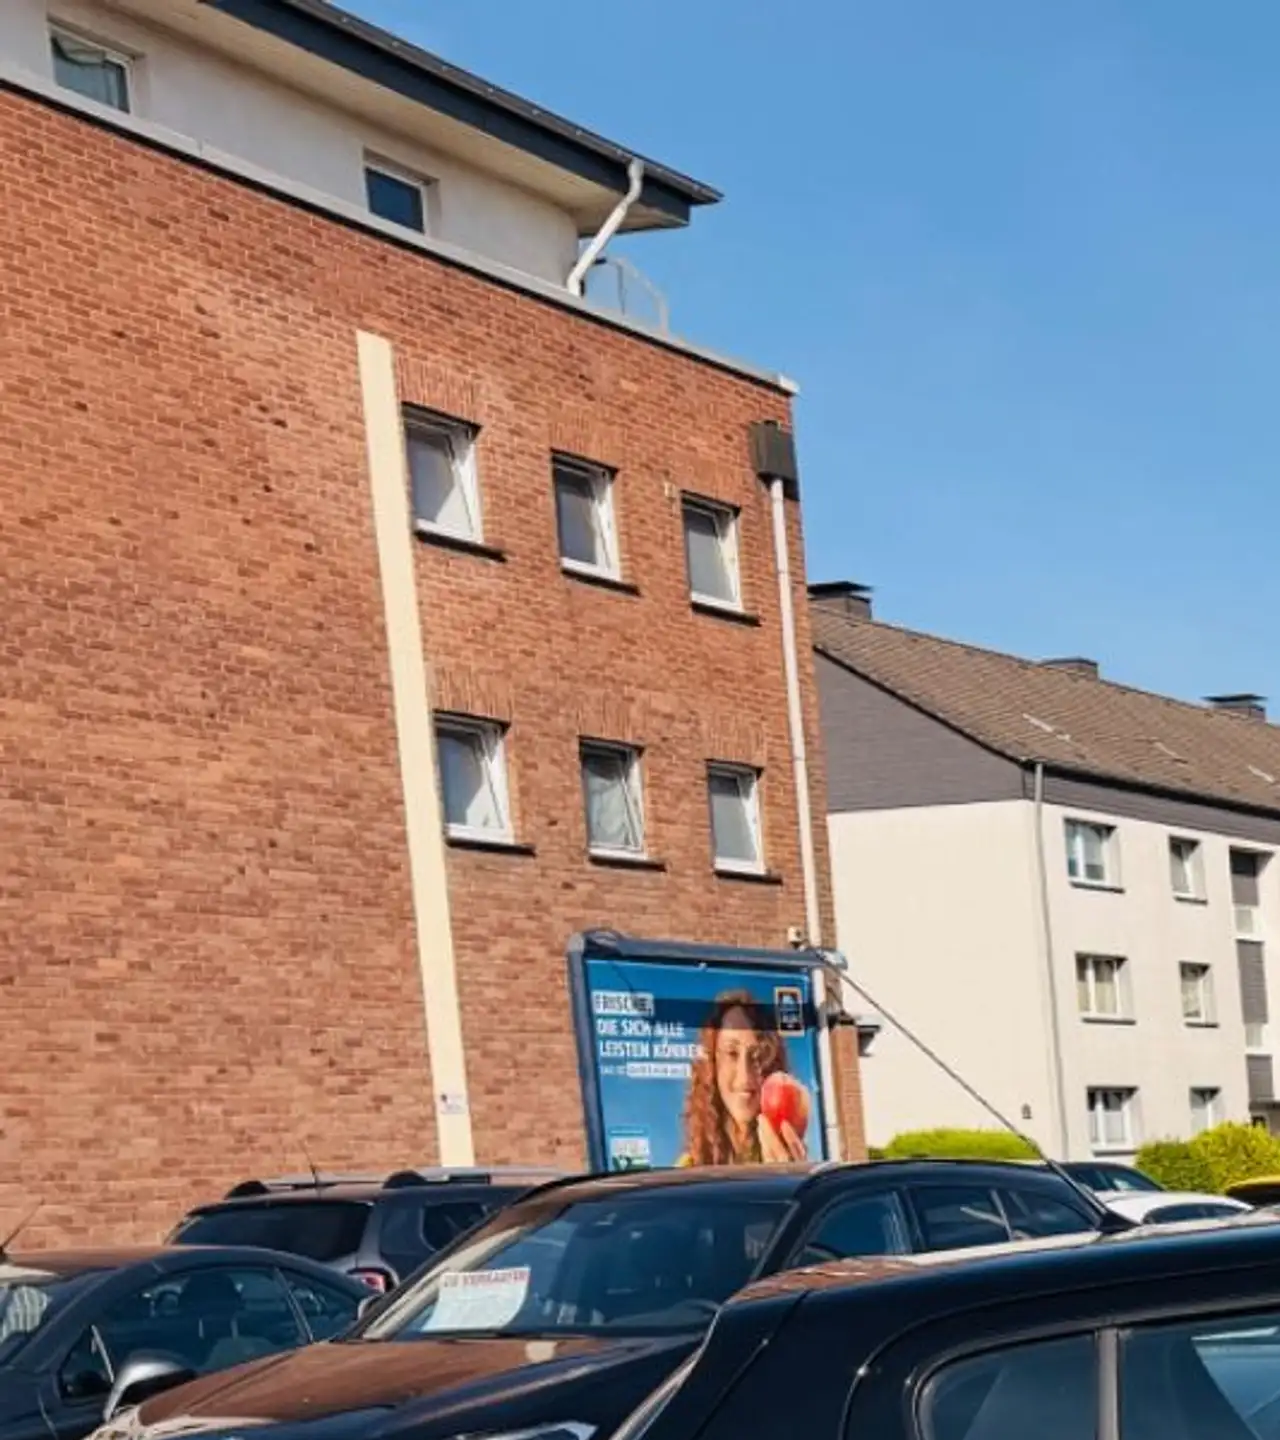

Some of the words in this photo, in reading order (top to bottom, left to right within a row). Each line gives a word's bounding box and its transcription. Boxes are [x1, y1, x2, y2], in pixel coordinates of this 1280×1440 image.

[597, 1018, 617, 1034] DIE
[599, 1039, 649, 1057] LEISTEN
[463, 1270, 529, 1286] VERKAUFEN
